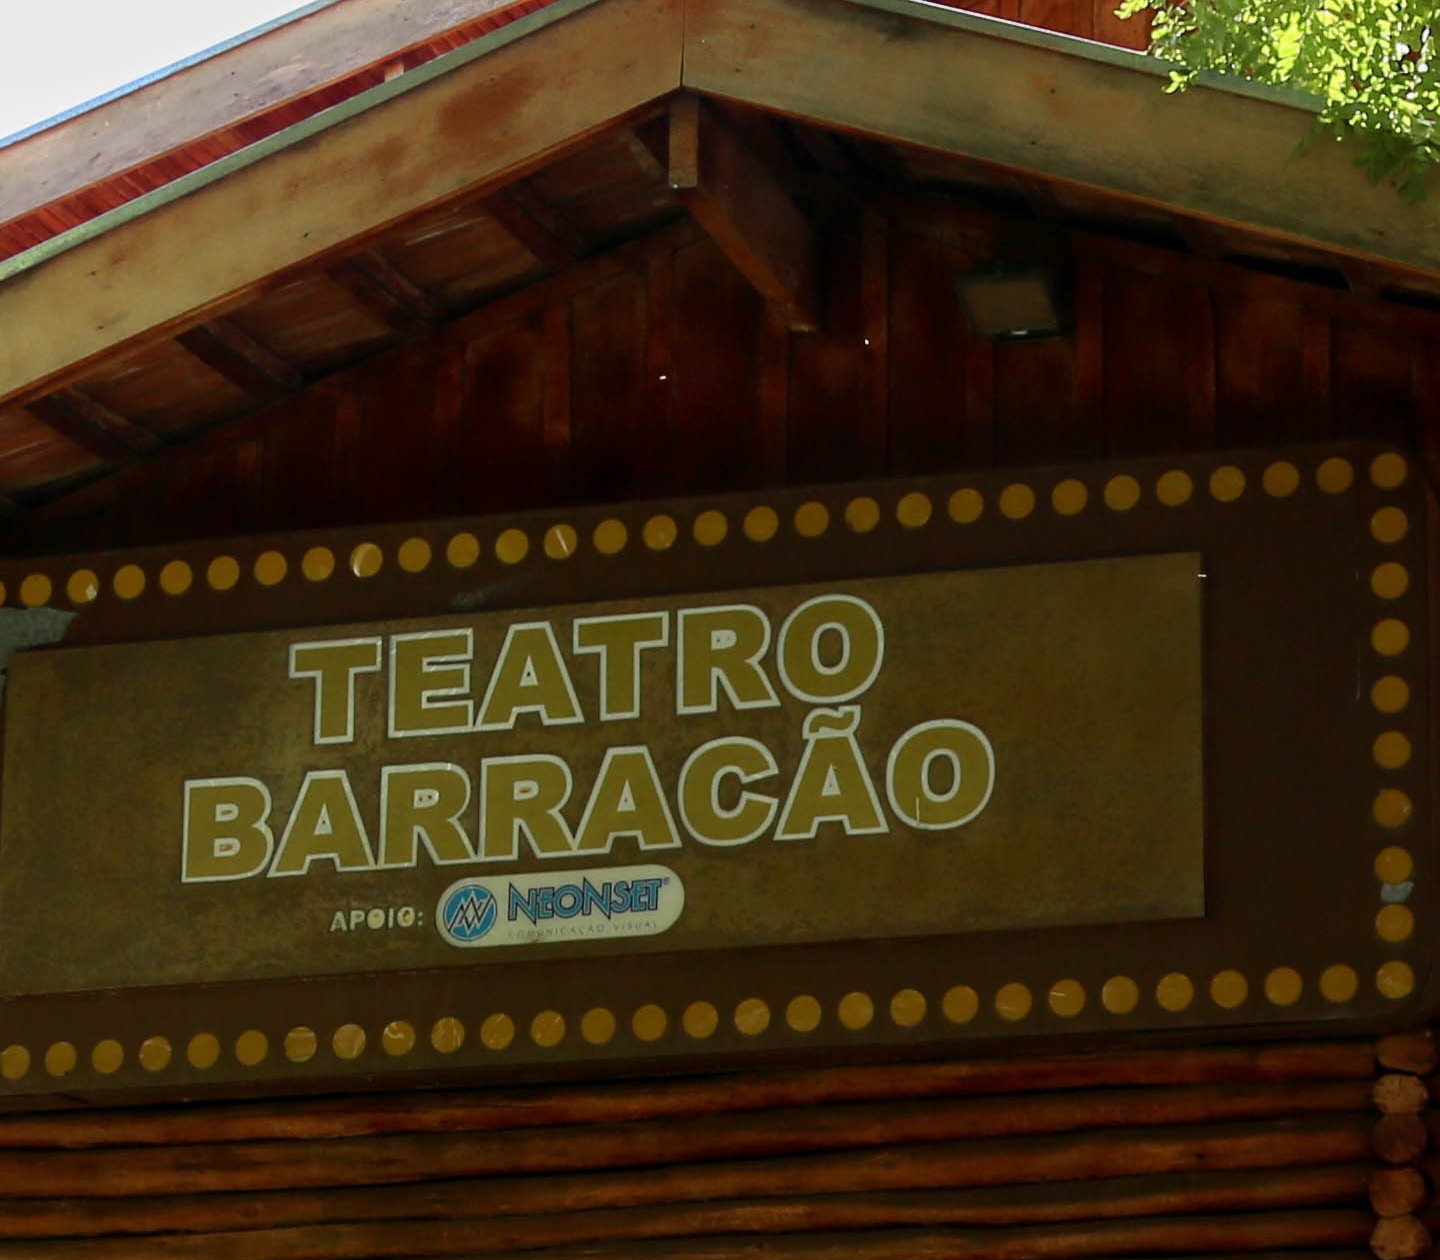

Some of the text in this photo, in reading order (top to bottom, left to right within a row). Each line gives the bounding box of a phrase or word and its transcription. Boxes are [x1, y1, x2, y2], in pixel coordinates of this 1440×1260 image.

[289, 593, 885, 746] TEATRO
[180, 705, 996, 883] BARRACÃO
[329, 906, 424, 933] APOIO:
[508, 921, 657, 940] COMUNICAÇÃO VISUAL
